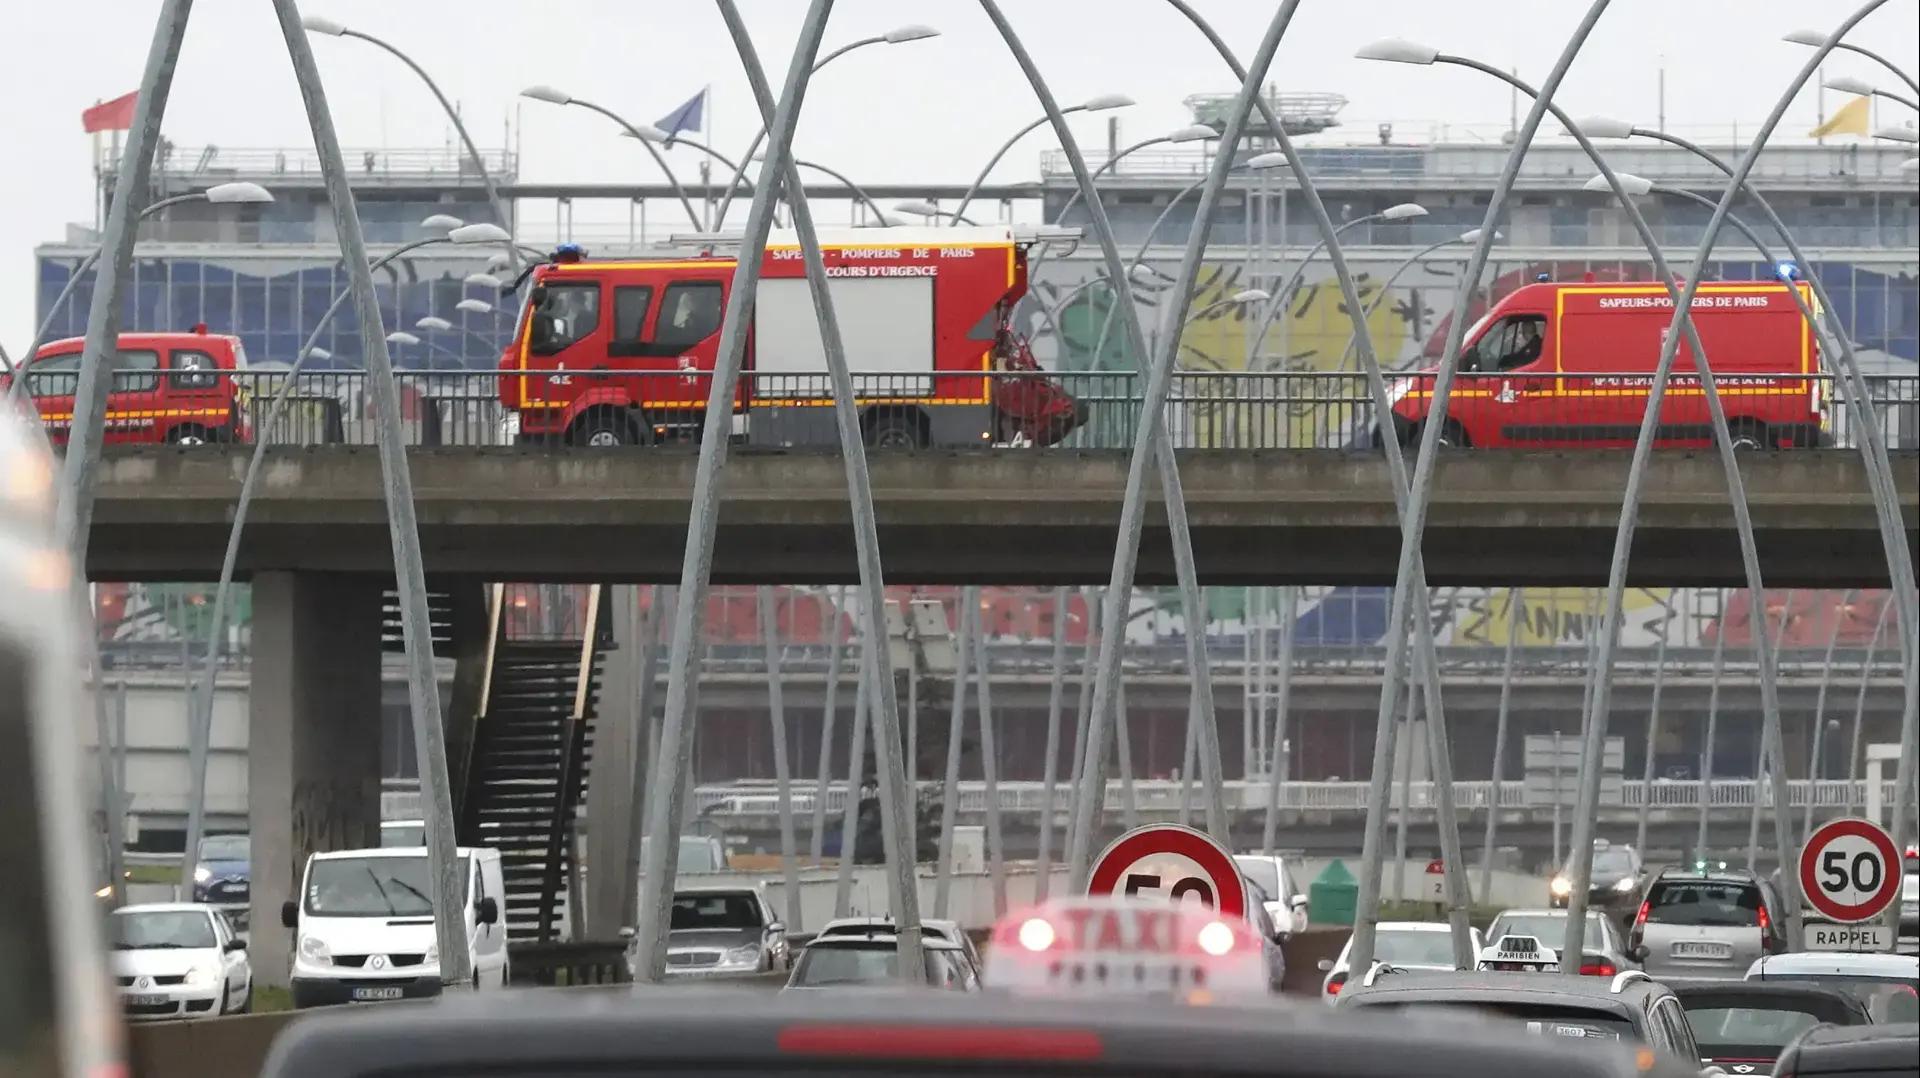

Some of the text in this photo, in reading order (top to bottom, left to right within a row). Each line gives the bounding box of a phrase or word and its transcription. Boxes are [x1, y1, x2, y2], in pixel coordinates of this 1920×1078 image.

[772, 250, 825, 259] SAPES
[841, 248, 901, 259] POMPIERS
[912, 248, 929, 258] DE
[940, 247, 975, 258] PARIS
[825, 265, 938, 277] COURS D'URGENCE
[1599, 296, 1768, 308] SAPEURS-POERS DE PARIS
[1821, 852, 1881, 893] 50
[1435, 883, 1442, 893] 2
[1063, 908, 1179, 951] TAXI
[1816, 931, 1880, 945] RAPPEL
[1502, 937, 1535, 952] TAXI
[1497, 952, 1540, 960] PARISIEN
